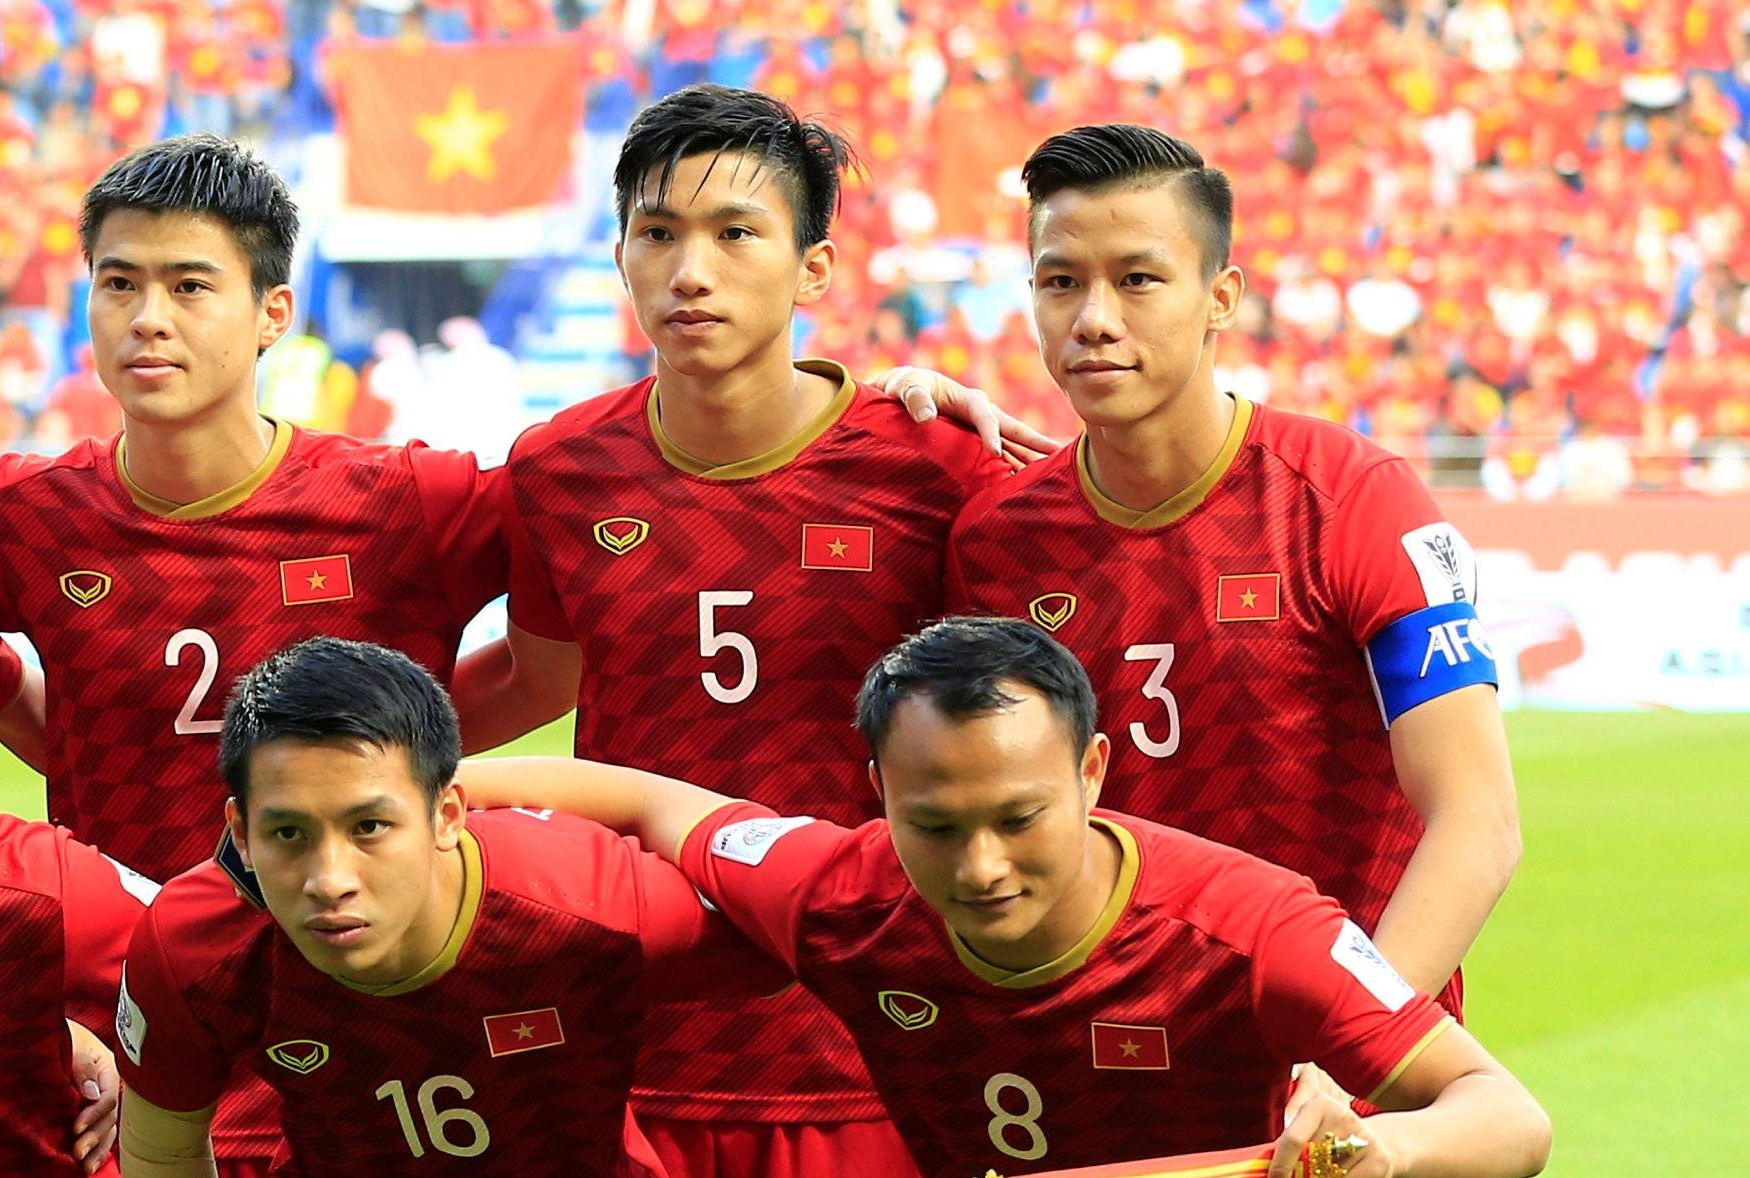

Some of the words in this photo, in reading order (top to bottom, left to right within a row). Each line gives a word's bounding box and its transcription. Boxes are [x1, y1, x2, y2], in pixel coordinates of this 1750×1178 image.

[165, 628, 227, 735] 2
[699, 590, 758, 704] 5
[1124, 643, 1181, 758] 3
[375, 1075, 492, 1159] 16
[983, 1072, 1048, 1161] 8
